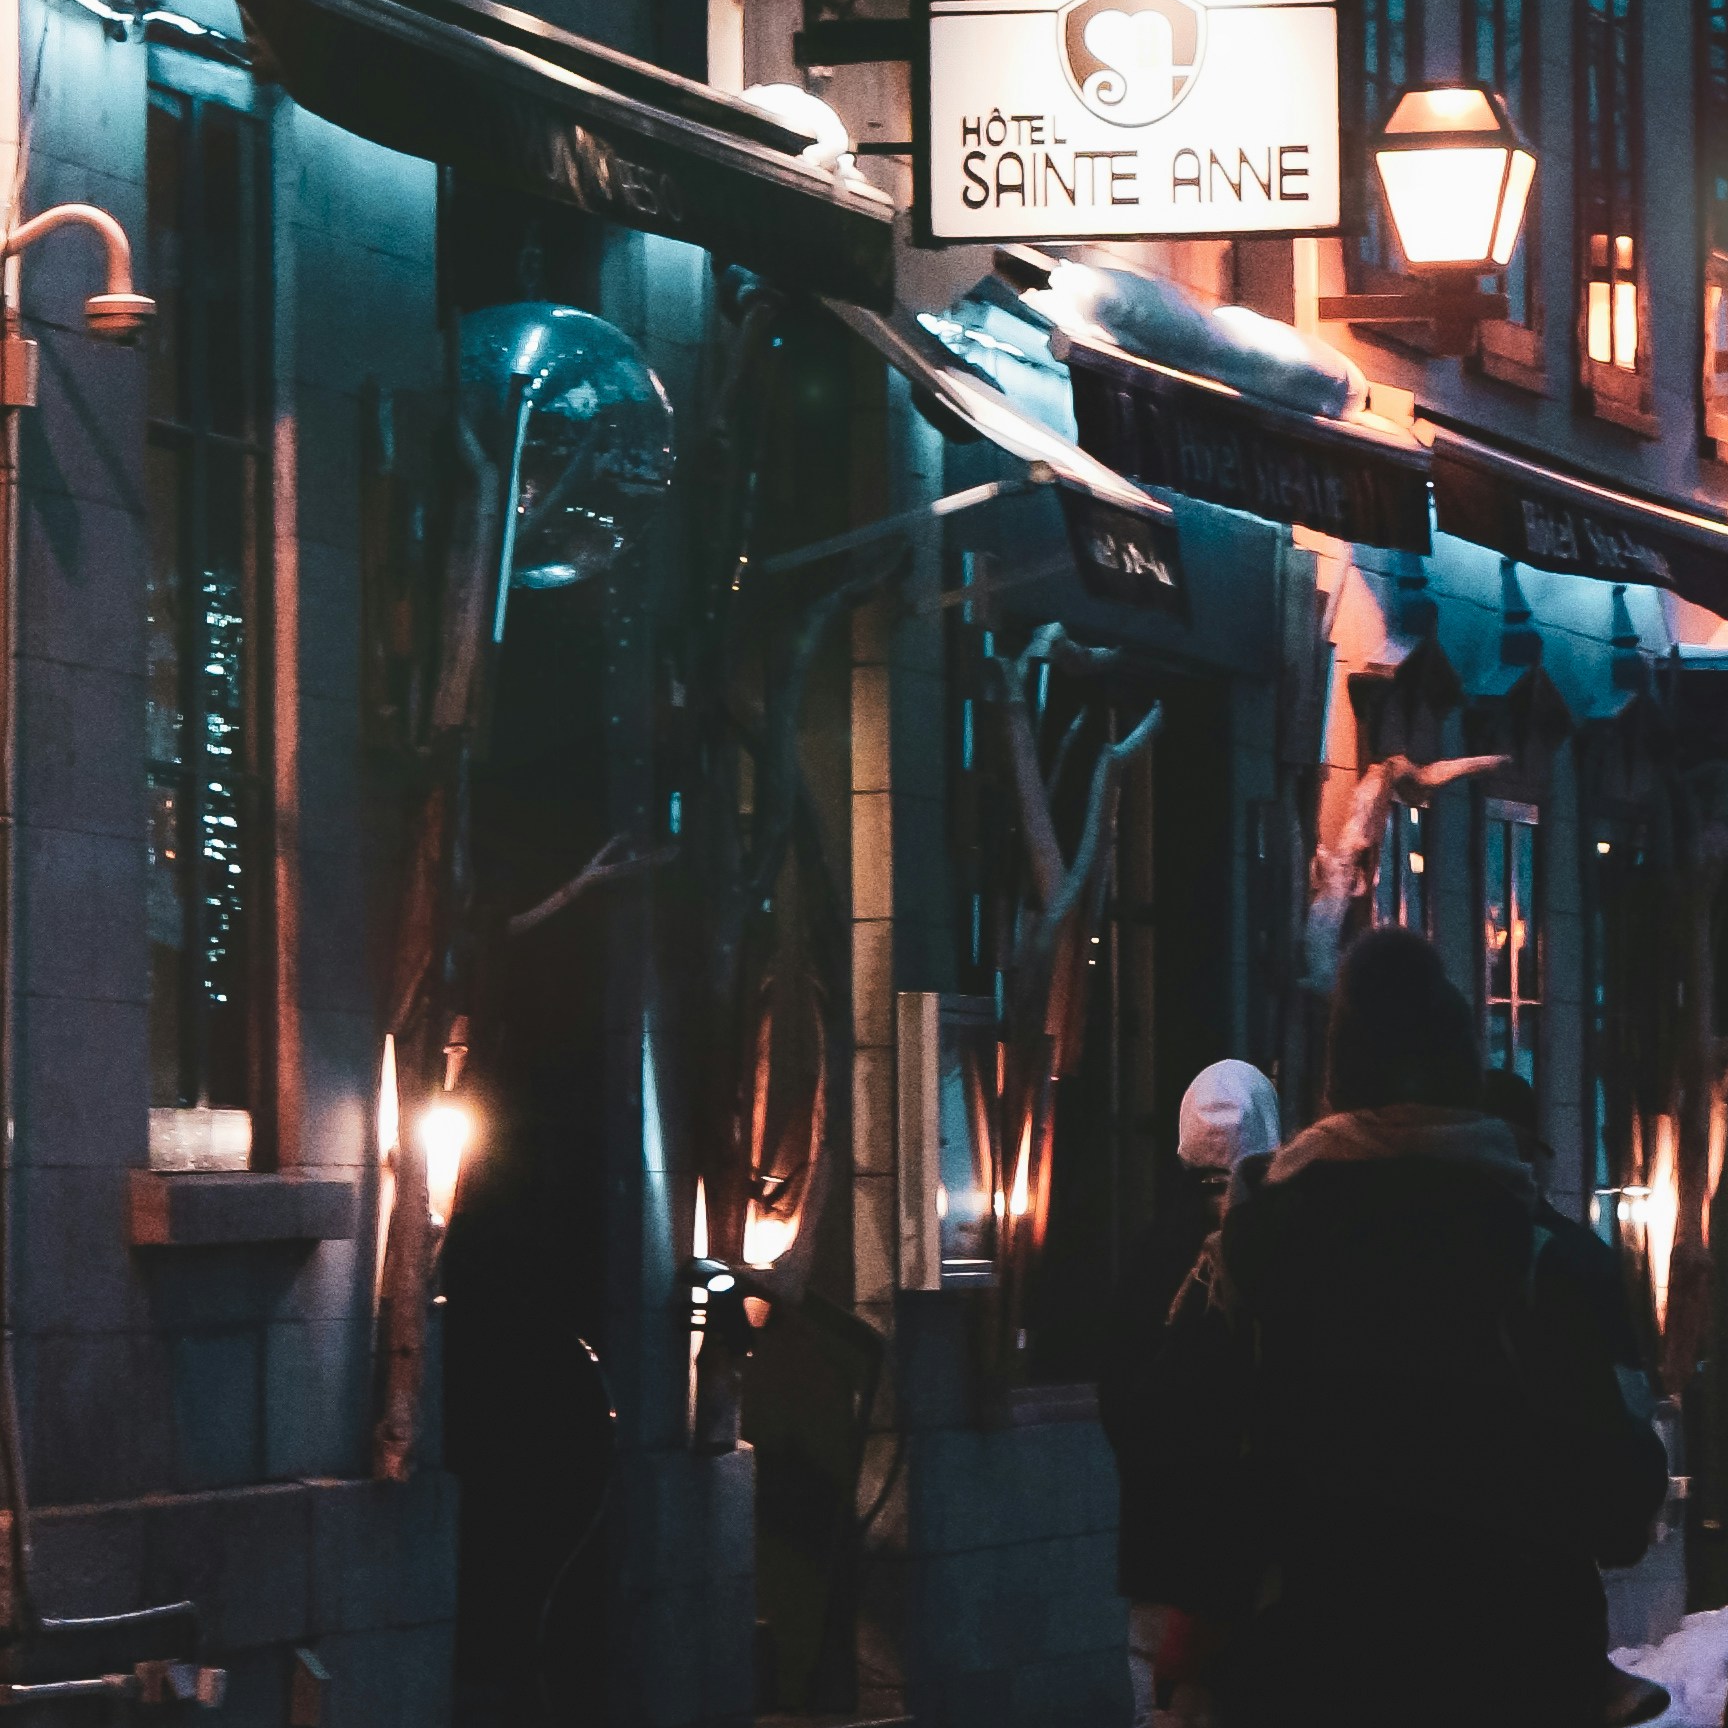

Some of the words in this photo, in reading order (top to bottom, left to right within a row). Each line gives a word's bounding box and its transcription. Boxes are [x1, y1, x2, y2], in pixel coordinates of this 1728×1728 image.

[962, 108, 1066, 147] HÔTEL
[962, 150, 1139, 209] SAINTE
[1172, 145, 1309, 203] ANNE
